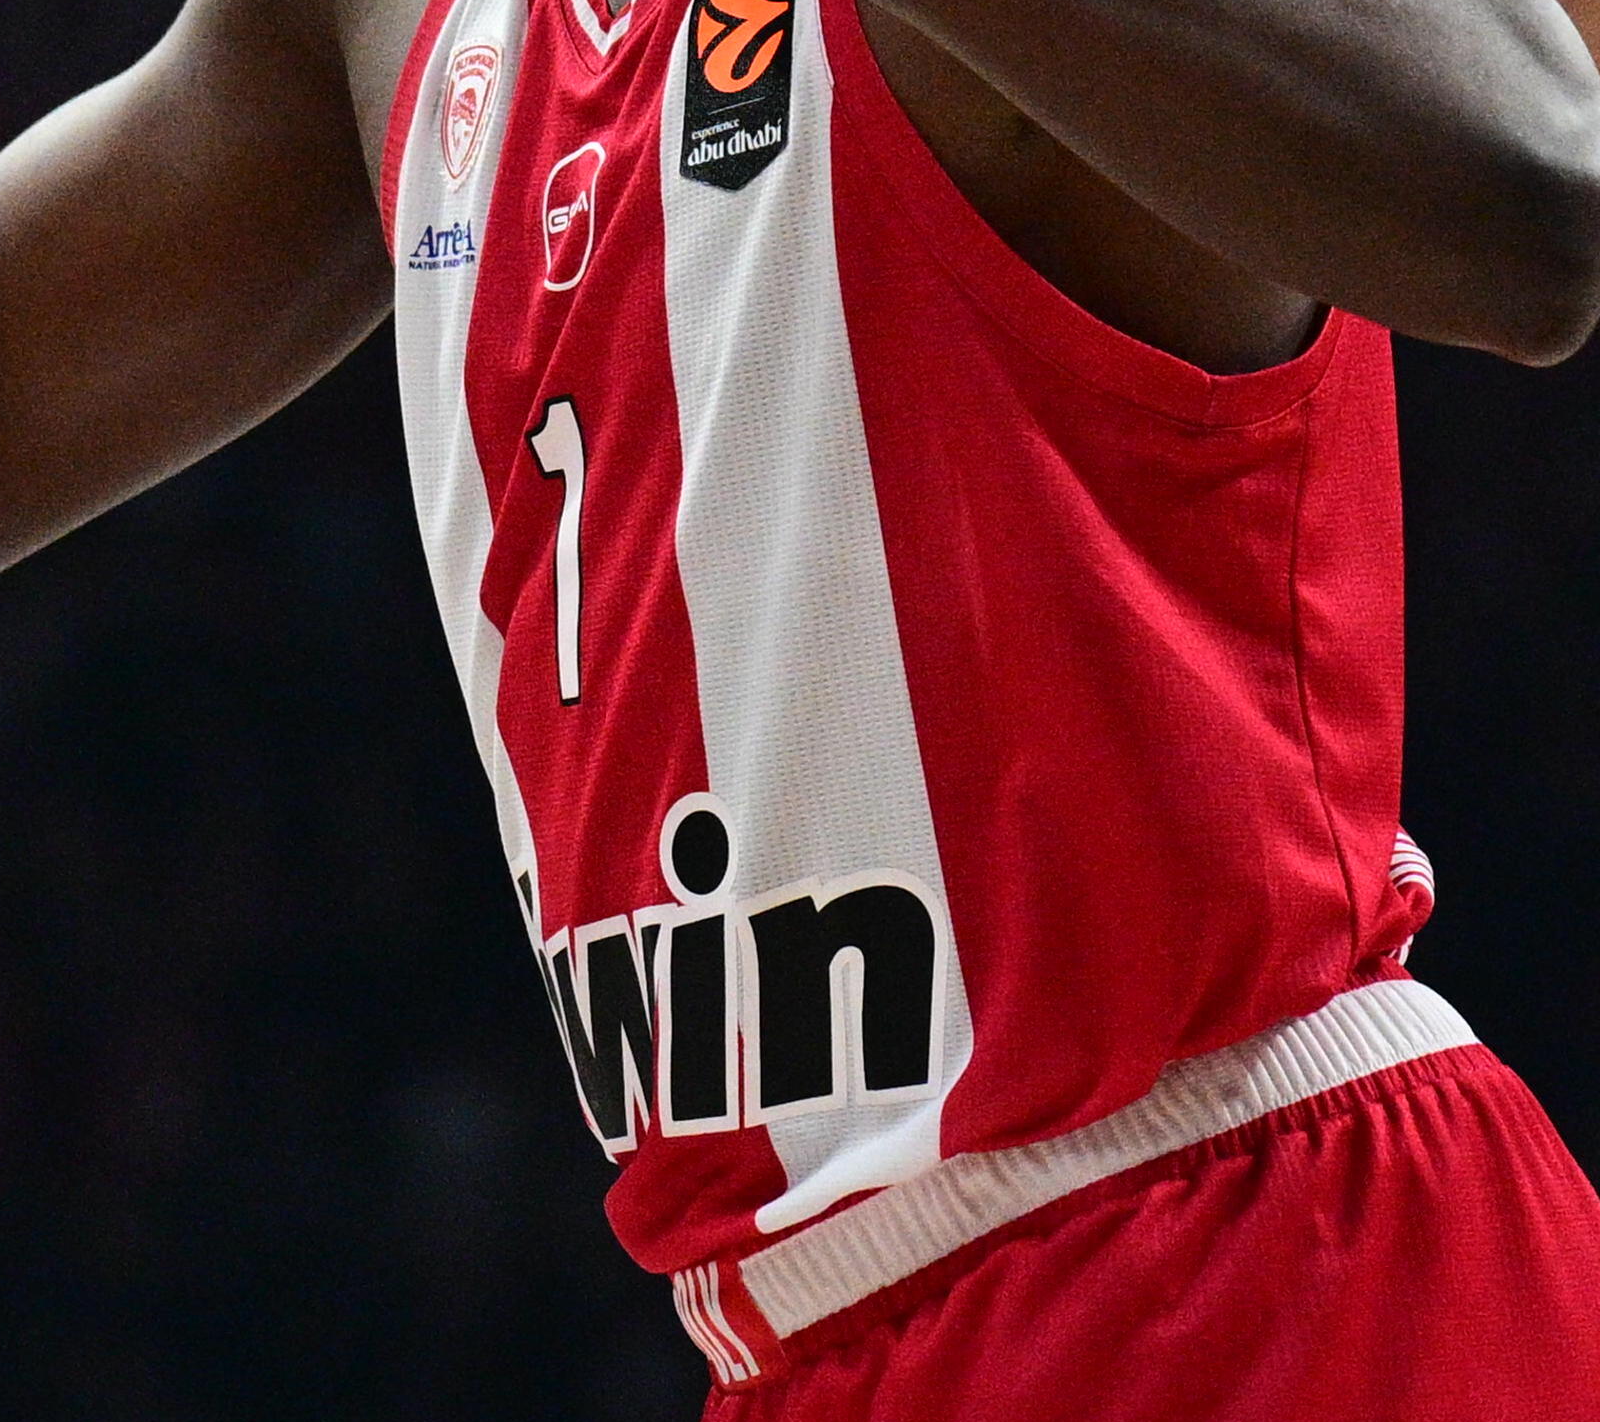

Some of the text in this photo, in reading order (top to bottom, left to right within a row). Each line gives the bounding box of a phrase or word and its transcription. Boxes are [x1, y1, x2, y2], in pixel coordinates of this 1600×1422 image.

[687, 118, 782, 167] abu dhabi
[525, 394, 585, 707] 1
[514, 791, 943, 1163] win
